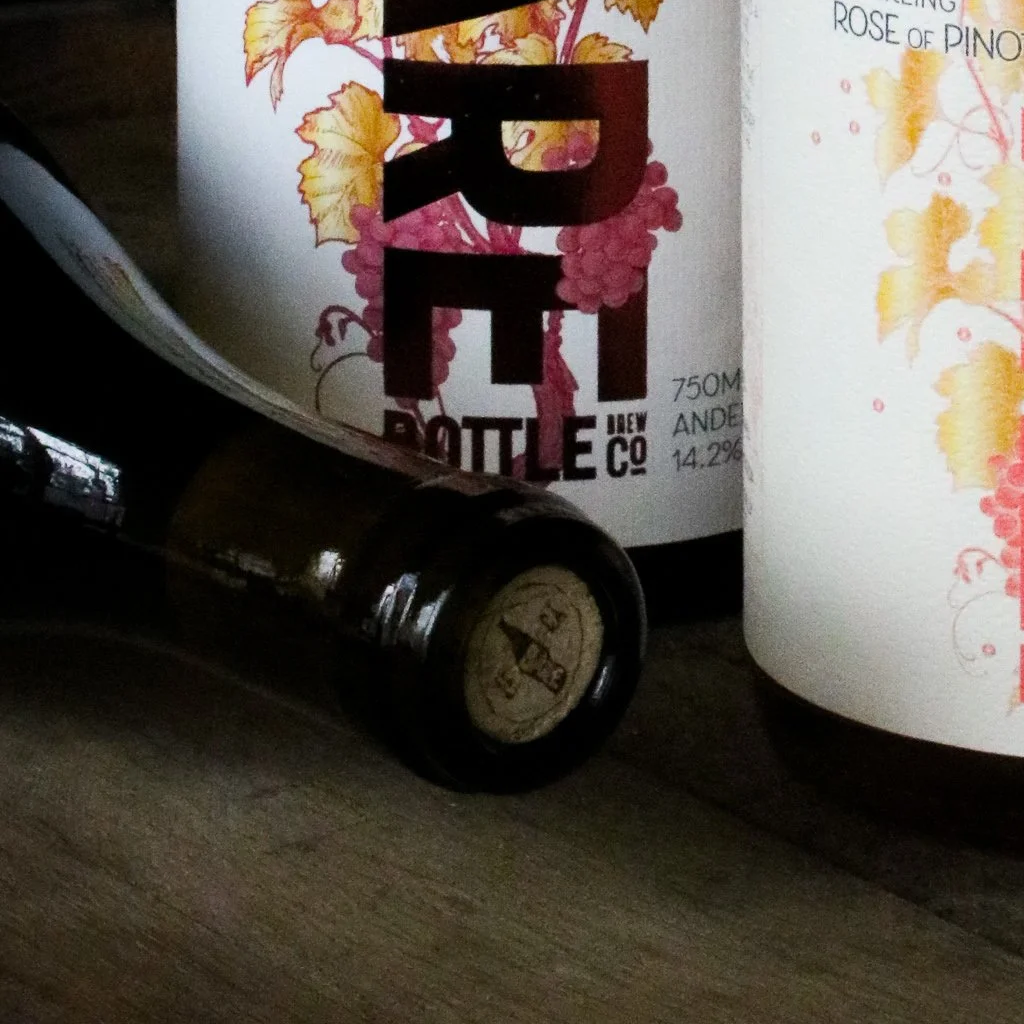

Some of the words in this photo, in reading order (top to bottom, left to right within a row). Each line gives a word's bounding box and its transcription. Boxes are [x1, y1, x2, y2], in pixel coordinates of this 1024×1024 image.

[834, 0, 900, 45] ROSE
[908, 27, 934, 49] OF
[606, 410, 649, 436] BREW
[672, 402, 743, 438] ANDE
[672, 437, 742, 473] 14.2%
